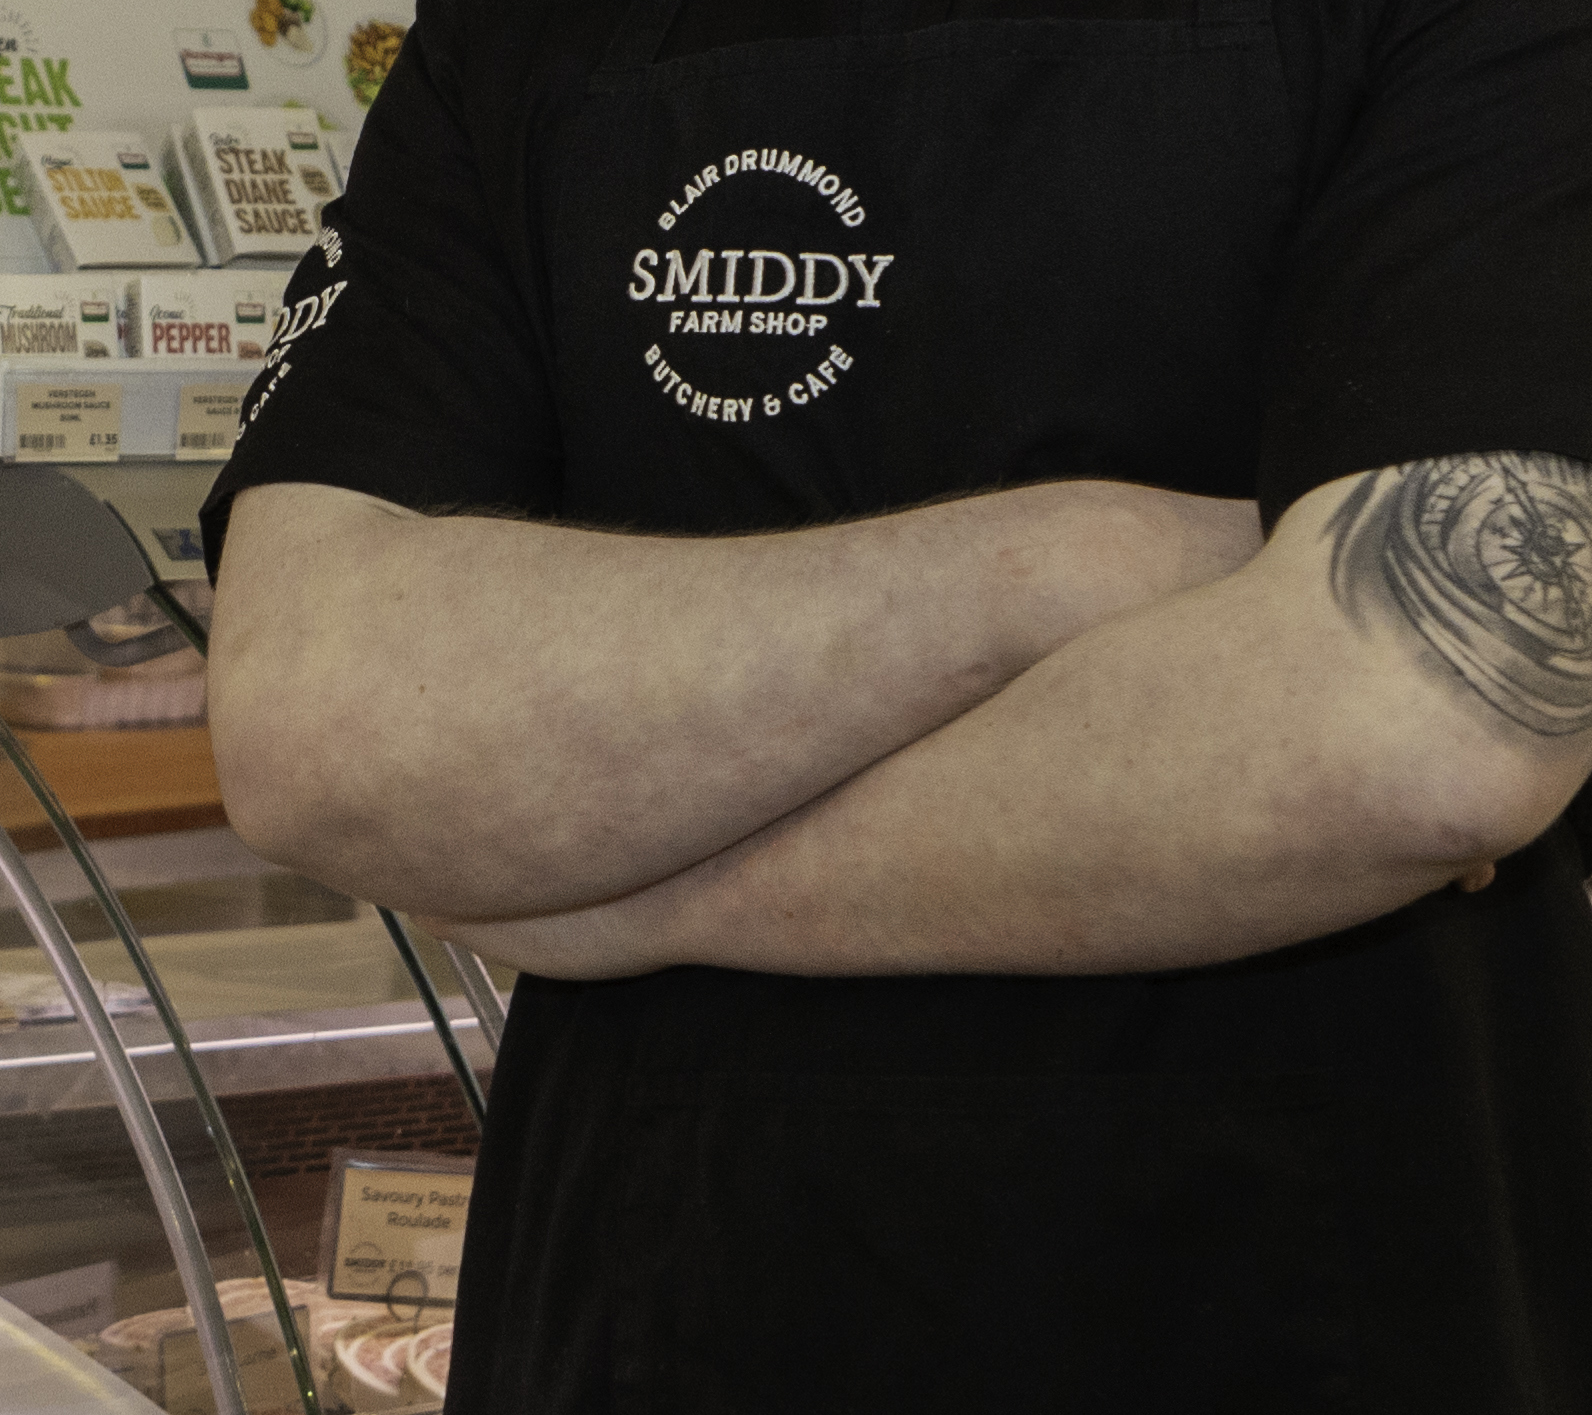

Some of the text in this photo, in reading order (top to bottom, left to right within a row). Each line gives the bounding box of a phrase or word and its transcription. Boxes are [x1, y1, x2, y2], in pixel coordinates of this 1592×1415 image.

[216, 149, 293, 176] STEAK
[225, 178, 296, 206] DIANE
[658, 147, 866, 230] BLAIR DRUMMOND
[59, 195, 141, 221] SAUCE
[235, 208, 314, 235] SAUCE
[628, 248, 893, 308] SMIDDY
[669, 310, 828, 337] FARM SHOP
[0, 322, 78, 354] MUSHROOM
[152, 322, 231, 355] PEPPER
[644, 344, 754, 423] BUTCHERY
[763, 394, 781, 417] &
[83, 400, 111, 410] SAUCE
[362, 1187, 424, 1209] Savoury
[387, 1211, 452, 1229] Roulade
